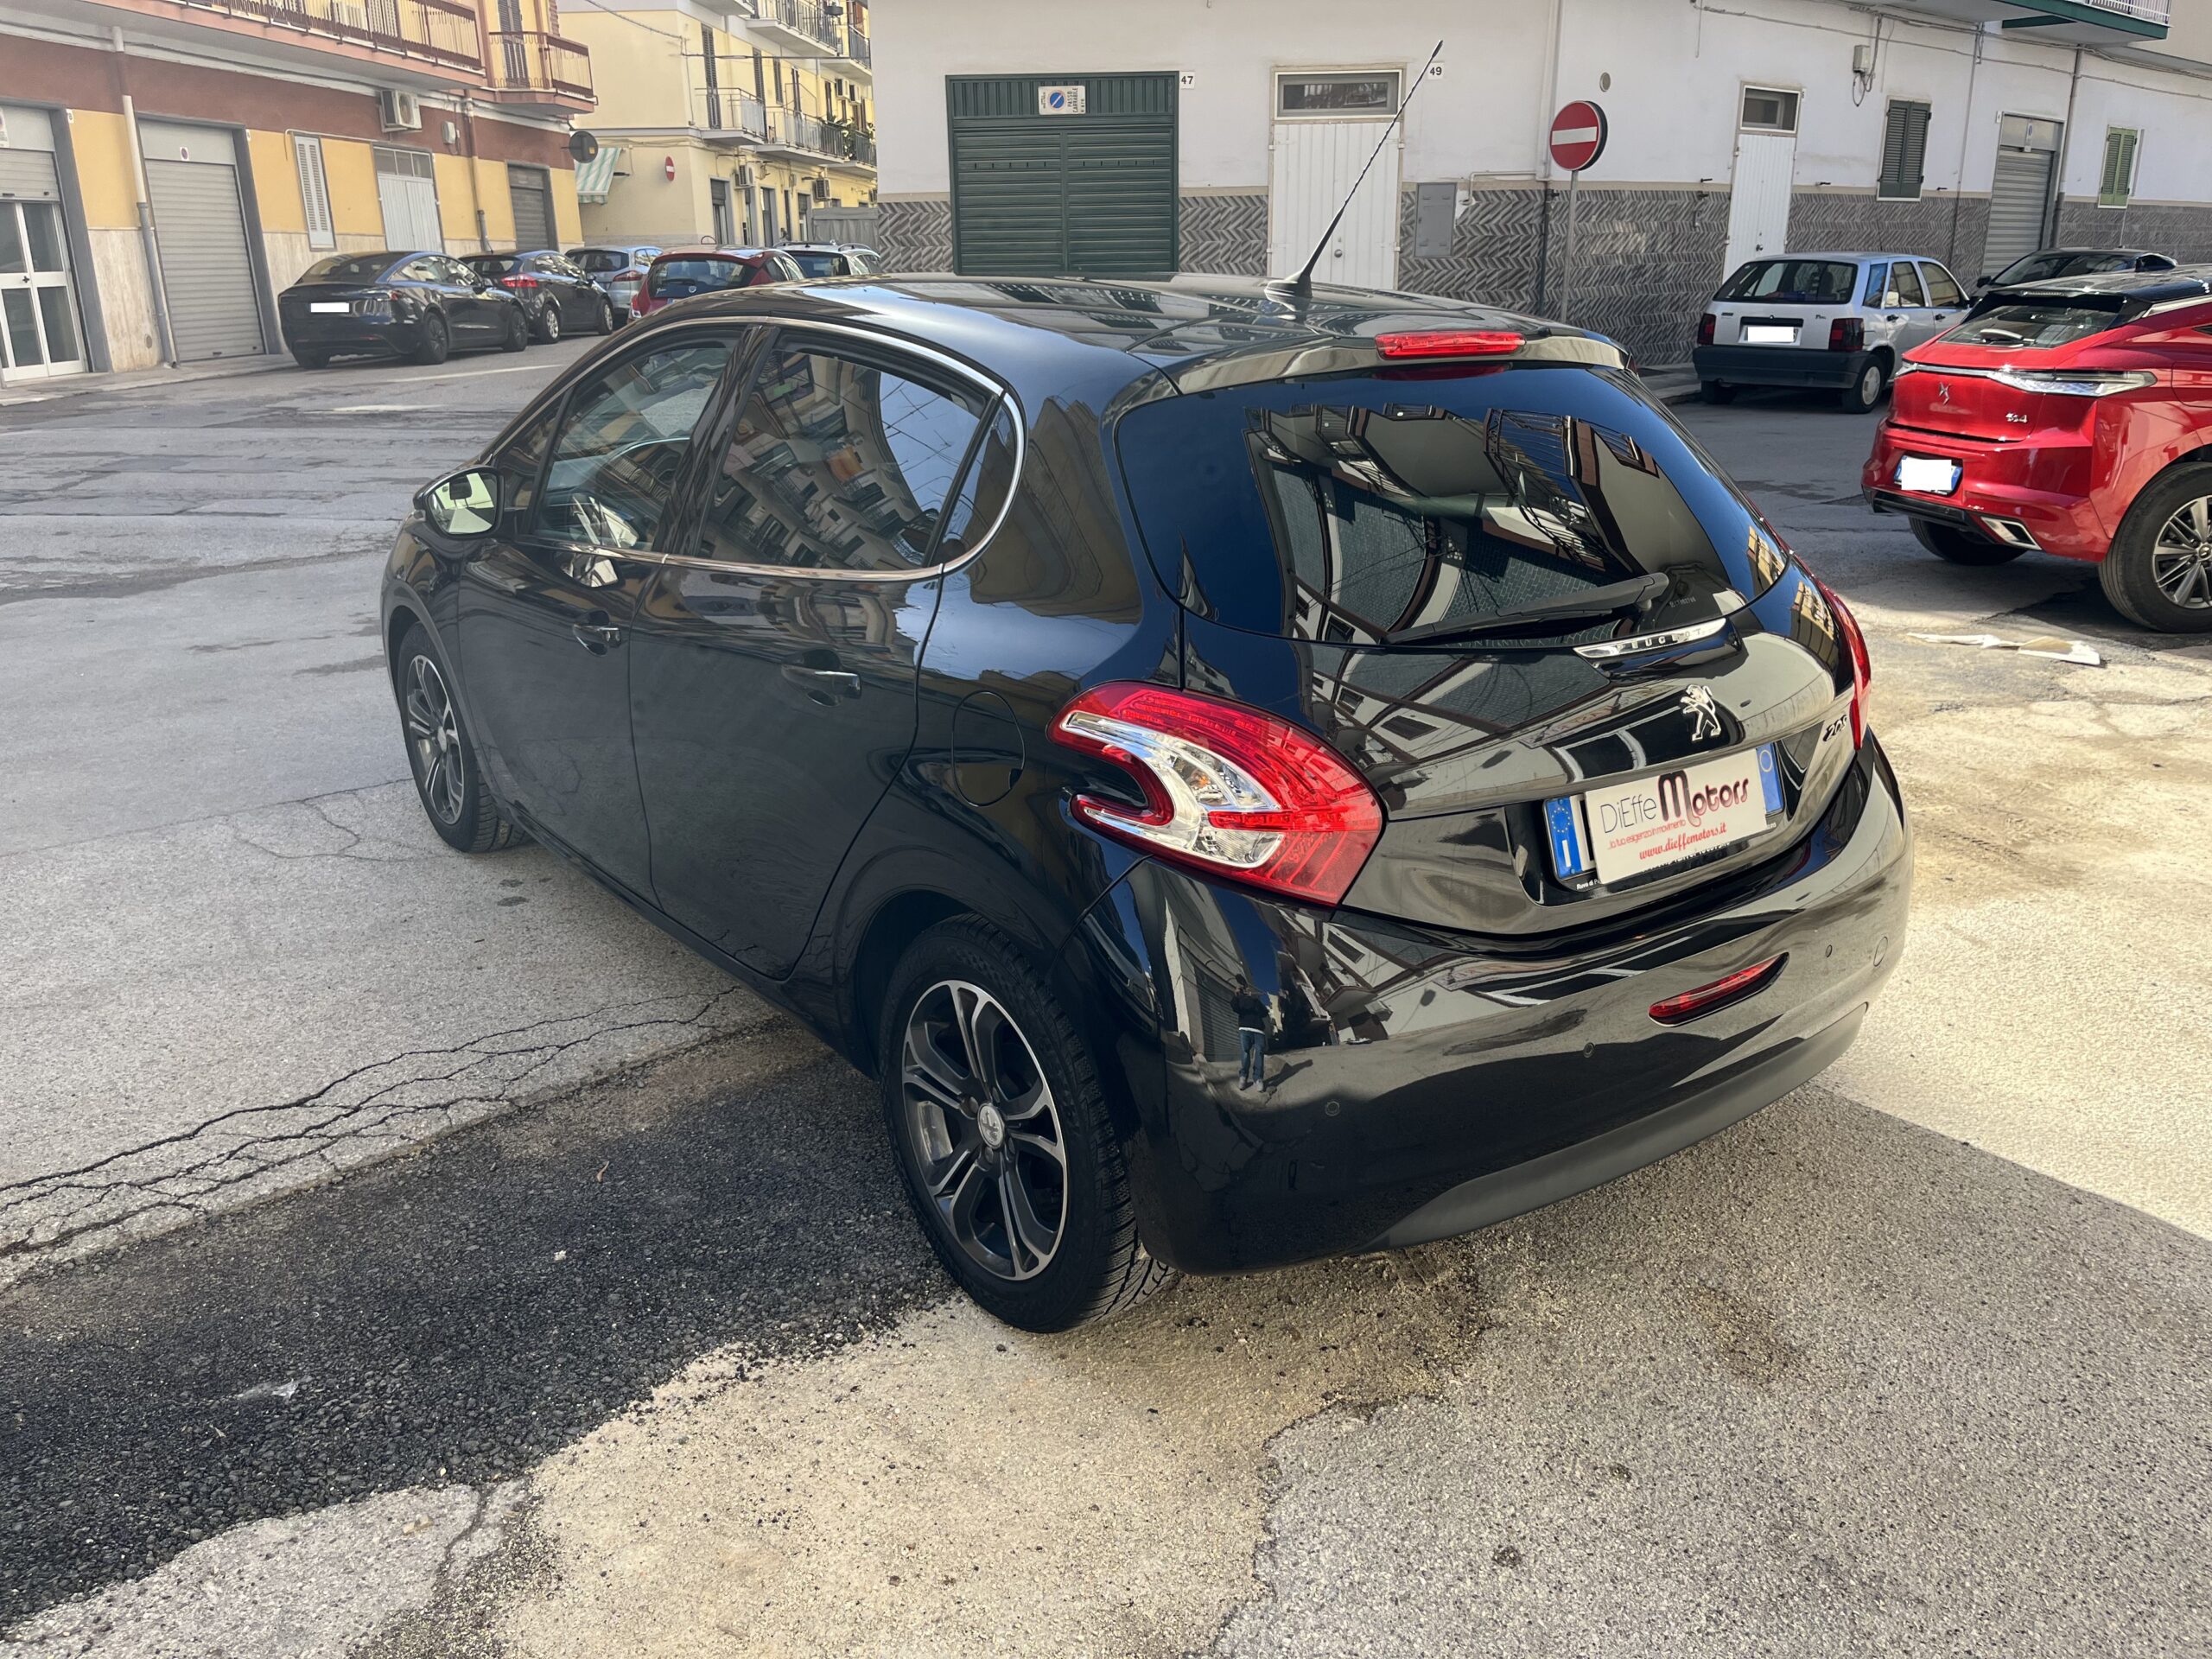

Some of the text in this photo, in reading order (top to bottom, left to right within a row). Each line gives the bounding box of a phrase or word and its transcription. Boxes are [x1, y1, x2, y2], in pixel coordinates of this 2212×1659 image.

[1180, 75, 1193, 85] 47
[1429, 66, 1442, 76] 49
[1600, 769, 1750, 834] DiEffe Motors
[1639, 822, 1727, 861] www.dieffemotors.it
